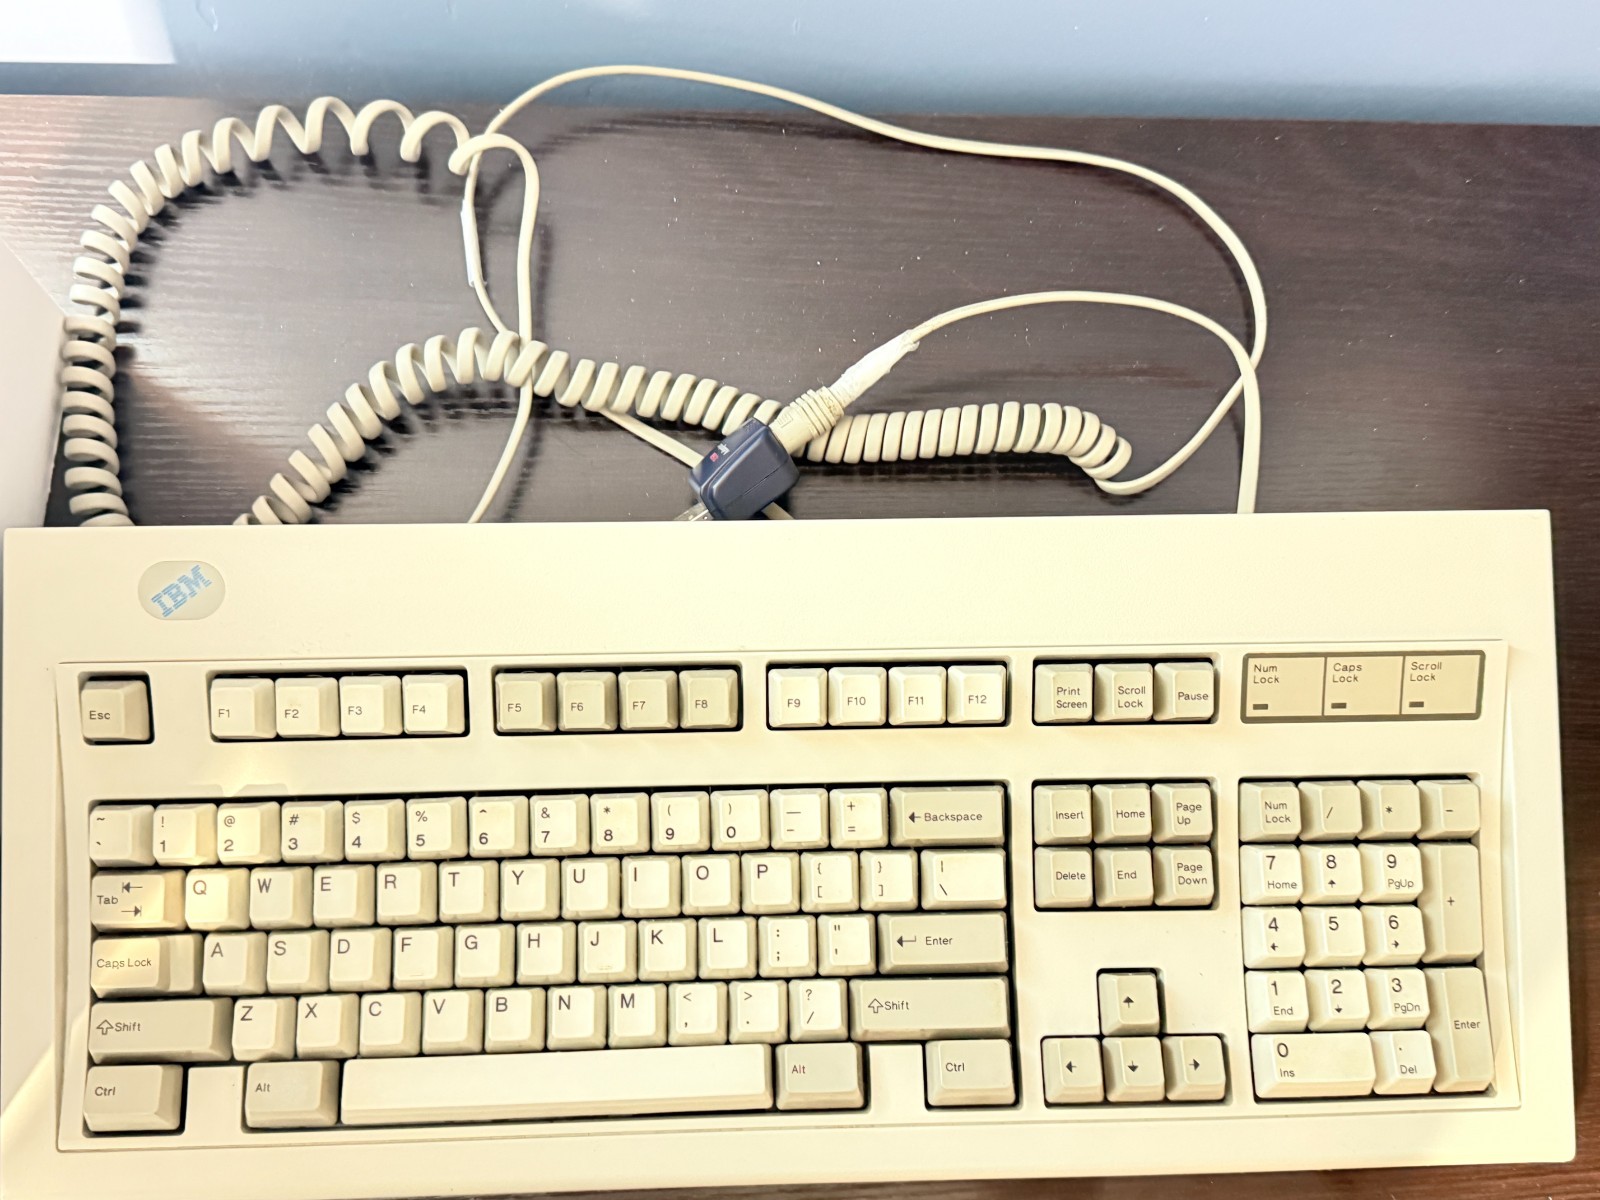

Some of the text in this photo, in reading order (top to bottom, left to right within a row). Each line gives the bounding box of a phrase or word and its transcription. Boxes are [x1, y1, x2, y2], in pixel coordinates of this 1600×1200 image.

[151, 564, 212, 617] IBM
[1254, 664, 1277, 672] Num
[1334, 663, 1362, 672] Caps
[1411, 662, 1442, 670] Scroll
[1254, 675, 1279, 684] Lock
[1333, 674, 1358, 683] Lock
[1057, 687, 1080, 695] Print
[1118, 686, 1145, 695] Scroll
[1178, 692, 1208, 700] Pause
[695, 700, 708, 708] F8
[788, 699, 800, 707] F9
[848, 697, 866, 705] F10
[908, 697, 923, 705] F11
[969, 695, 986, 704] F12
[1057, 700, 1087, 708] Screen
[1118, 699, 1143, 708] Lock
[348, 706, 362, 715] F3
[413, 705, 425, 714] F4
[508, 703, 521, 712] F5
[571, 703, 583, 711] F6
[633, 701, 645, 710] F7
[90, 711, 110, 720] Esc
[219, 709, 229, 717] F1
[285, 709, 299, 718] F2
[847, 802, 855, 810] +
[1176, 803, 1202, 813] Page
[1265, 801, 1287, 809] Num
[352, 812, 360, 824] $
[416, 811, 427, 822] %
[541, 807, 550, 818] &
[925, 813, 982, 822] Backspace
[1056, 811, 1083, 819] Insert
[1116, 810, 1145, 818] Home
[1326, 807, 1333, 818] /
[160, 816, 165, 827] !
[224, 816, 235, 827] @
[289, 814, 299, 825] #
[1177, 816, 1191, 825] Up
[1266, 815, 1291, 823] Lock
[666, 828, 674, 840] 9
[727, 826, 736, 838] 0
[848, 825, 855, 833] =
[416, 834, 425, 847] 5
[479, 833, 488, 845] 6
[542, 831, 550, 843] 7
[604, 829, 613, 841] 8
[159, 840, 166, 852] 1
[224, 839, 233, 851] 2
[288, 838, 298, 850] 3
[352, 836, 361, 848] 4
[1266, 856, 1275, 869] 7
[1327, 855, 1336, 869] 8
[1387, 854, 1396, 868] 9
[696, 866, 709, 880] O
[757, 864, 768, 878] P
[1177, 863, 1202, 873] Page
[448, 872, 460, 887] T
[512, 870, 524, 885] Y
[574, 869, 585, 883] U
[633, 867, 638, 882] I
[1056, 871, 1085, 880] Delete
[1117, 871, 1136, 879] End
[258, 878, 271, 893] W
[321, 877, 331, 891] E
[385, 874, 396, 889] R
[1178, 876, 1207, 885] Down
[1268, 881, 1297, 889] Home
[1388, 879, 1414, 889] PgUp
[193, 880, 206, 895] Q
[939, 884, 947, 895] \
[97, 895, 118, 904] Tab
[1447, 897, 1455, 905] +
[1269, 917, 1278, 931] 4
[1329, 917, 1339, 931] 5
[1389, 915, 1399, 929] 6
[528, 933, 540, 948] H
[590, 931, 599, 946] J
[652, 930, 663, 944] K
[714, 928, 723, 942] L
[926, 936, 952, 945] Enter
[338, 939, 350, 954] D
[402, 937, 412, 952] F
[465, 935, 477, 950] G
[211, 942, 223, 957] A
[274, 941, 286, 956] S
[776, 952, 780, 961] ;
[97, 958, 151, 969] Caps Lock
[1270, 981, 1278, 995] 1
[1331, 979, 1342, 994] 2
[1392, 978, 1402, 992] 3
[683, 993, 691, 1001] <
[744, 992, 752, 1000] >
[805, 989, 813, 999] ?
[496, 997, 507, 1012] B
[559, 995, 570, 1010] N
[621, 993, 634, 1008] M
[885, 1001, 909, 1010] Shift
[305, 1003, 317, 1018] X
[369, 1001, 381, 1016] C
[433, 999, 445, 1014] V
[1274, 1006, 1293, 1015] End
[1394, 1003, 1420, 1014] PgDn
[241, 1006, 253, 1021] Z
[807, 1012, 814, 1024] /
[115, 1022, 140, 1032] Shift
[1454, 1020, 1480, 1029] Enter
[1277, 1043, 1288, 1057] 0
[792, 1065, 805, 1074] Alt
[946, 1063, 964, 1072] Ctrl
[1280, 1069, 1295, 1077] Ins
[1400, 1065, 1417, 1074] Del
[95, 1087, 115, 1096] Ctrl
[255, 1083, 270, 1092] Alt
